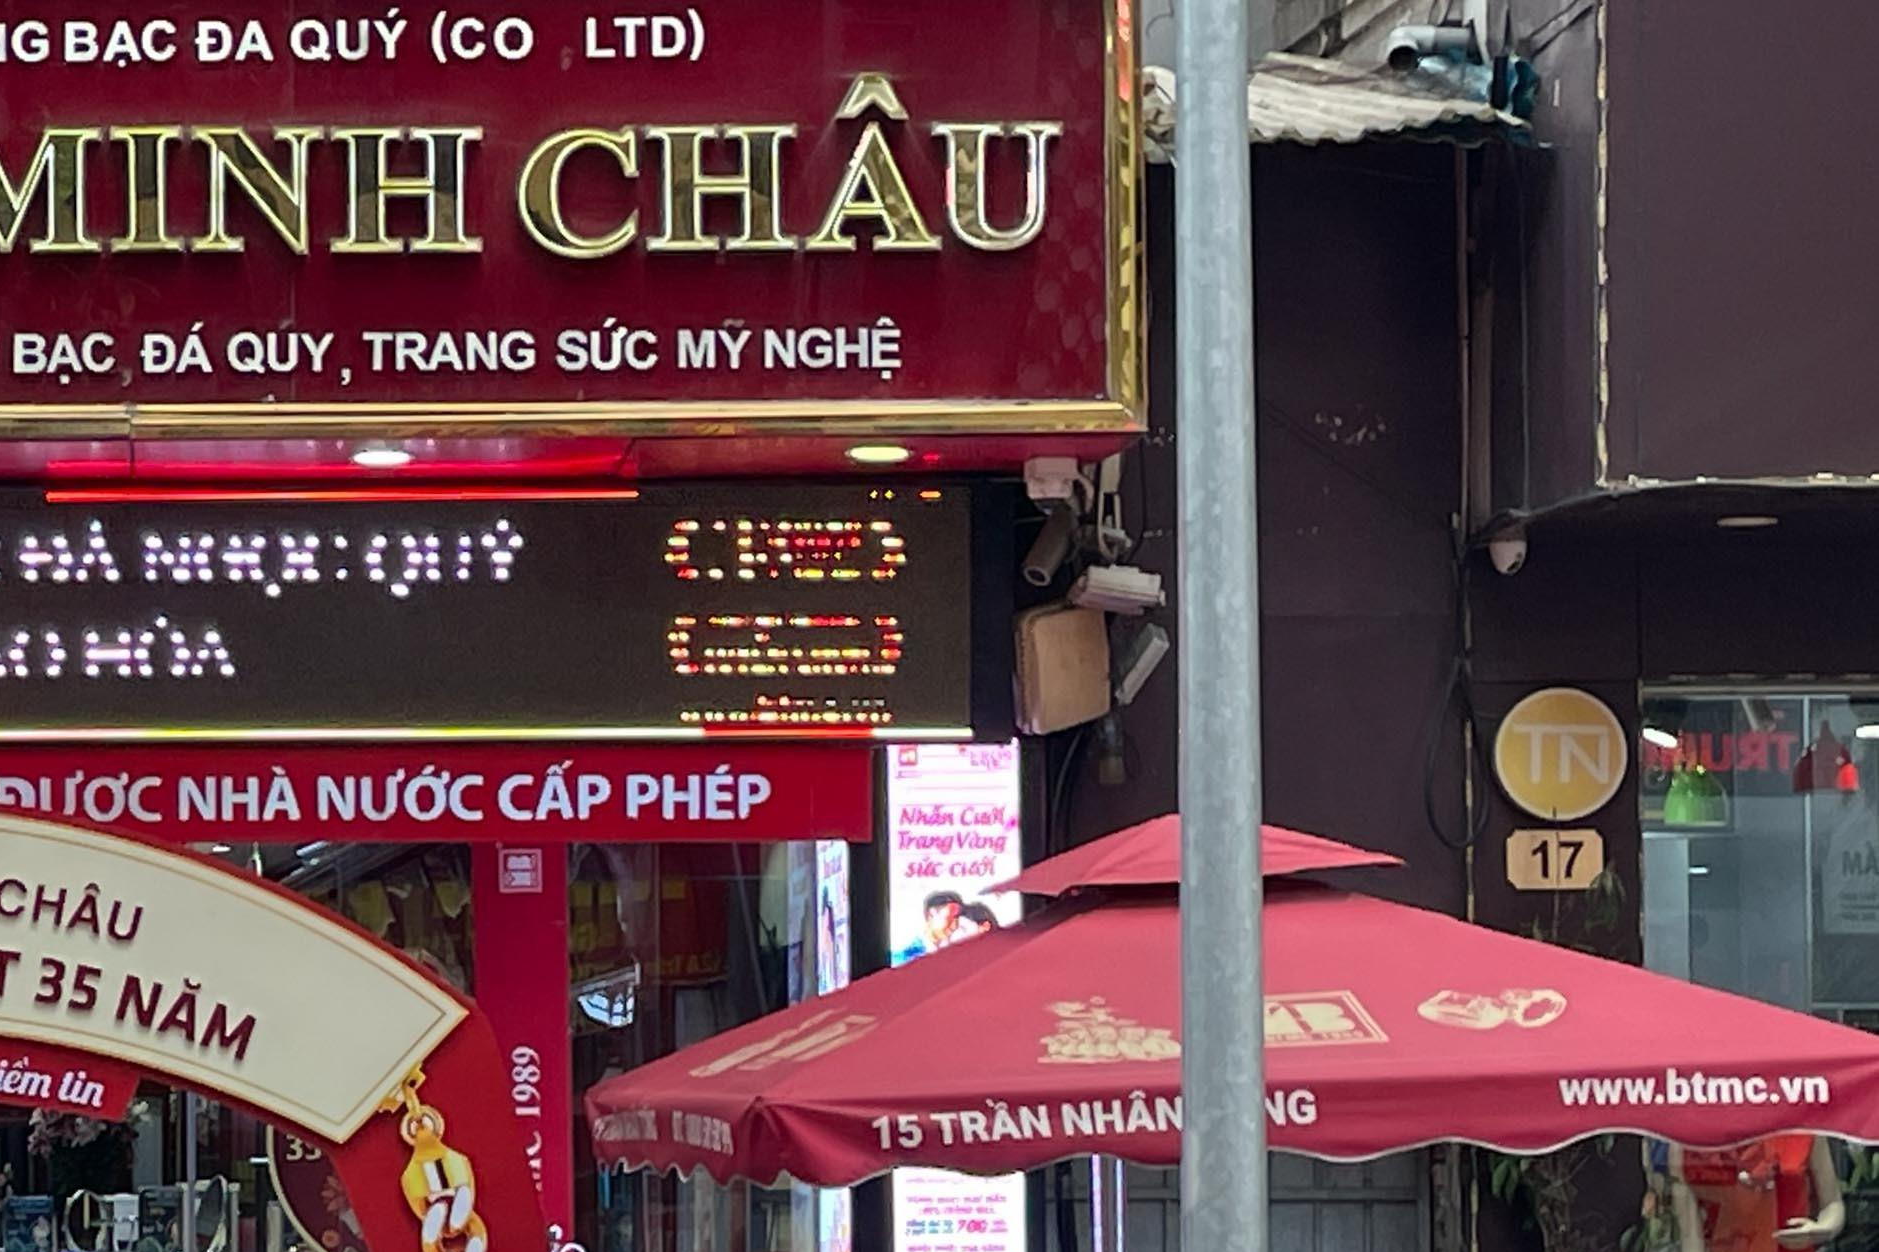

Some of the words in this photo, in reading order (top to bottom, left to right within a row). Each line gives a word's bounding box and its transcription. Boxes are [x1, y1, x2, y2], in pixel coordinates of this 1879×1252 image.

[64, 19, 177, 68] BẠC
[195, 19, 275, 62] ĐA
[289, 8, 407, 62] QUÝ
[584, 12, 707, 62] LTD)
[516, 72, 1063, 260] CHÂU
[139, 320, 209, 374] ĐÁ
[363, 328, 537, 372] TRANG
[554, 317, 658, 371] SỨC
[676, 316, 753, 370] MỸ
[763, 315, 904, 379] NGHỆ
[1511, 723, 1611, 785] TN
[178, 766, 301, 822] NHÀ
[317, 764, 485, 822] NƯỚC
[497, 760, 612, 821] CẤP
[626, 763, 773, 820] PHÉP
[898, 804, 955, 827] Nhẫn
[897, 831, 954, 855] Trang
[955, 831, 1008, 854] Vàng
[1530, 841, 1584, 880] 17
[33, 955, 103, 1014] 35
[115, 973, 260, 1064] NĂM
[56, 1068, 106, 1110] tin
[510, 1045, 542, 1118] 1989
[1559, 1067, 1830, 1107] www.btmc.vn
[871, 1111, 923, 1153] 15
[930, 1097, 1051, 1146] TRẦN
[1065, 1089, 1183, 1138] NHÂN
